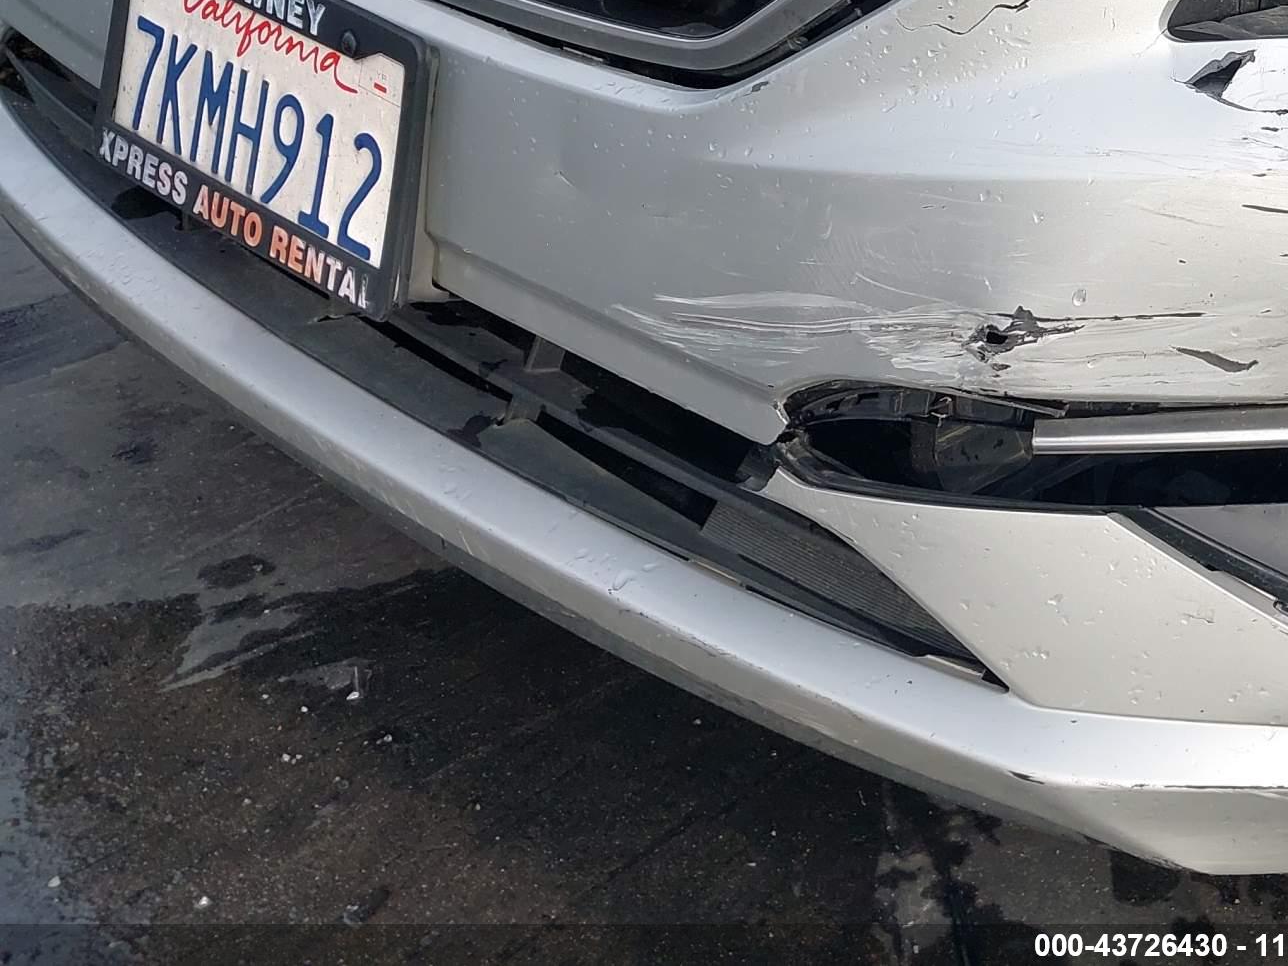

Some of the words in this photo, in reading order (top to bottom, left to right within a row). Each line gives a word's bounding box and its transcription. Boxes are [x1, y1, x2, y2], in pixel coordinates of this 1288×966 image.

[100, 127, 188, 205] XPRESS
[192, 184, 263, 247] AUTO
[268, 225, 371, 310] RENTAL
[131, 14, 383, 262] 7KMH912
